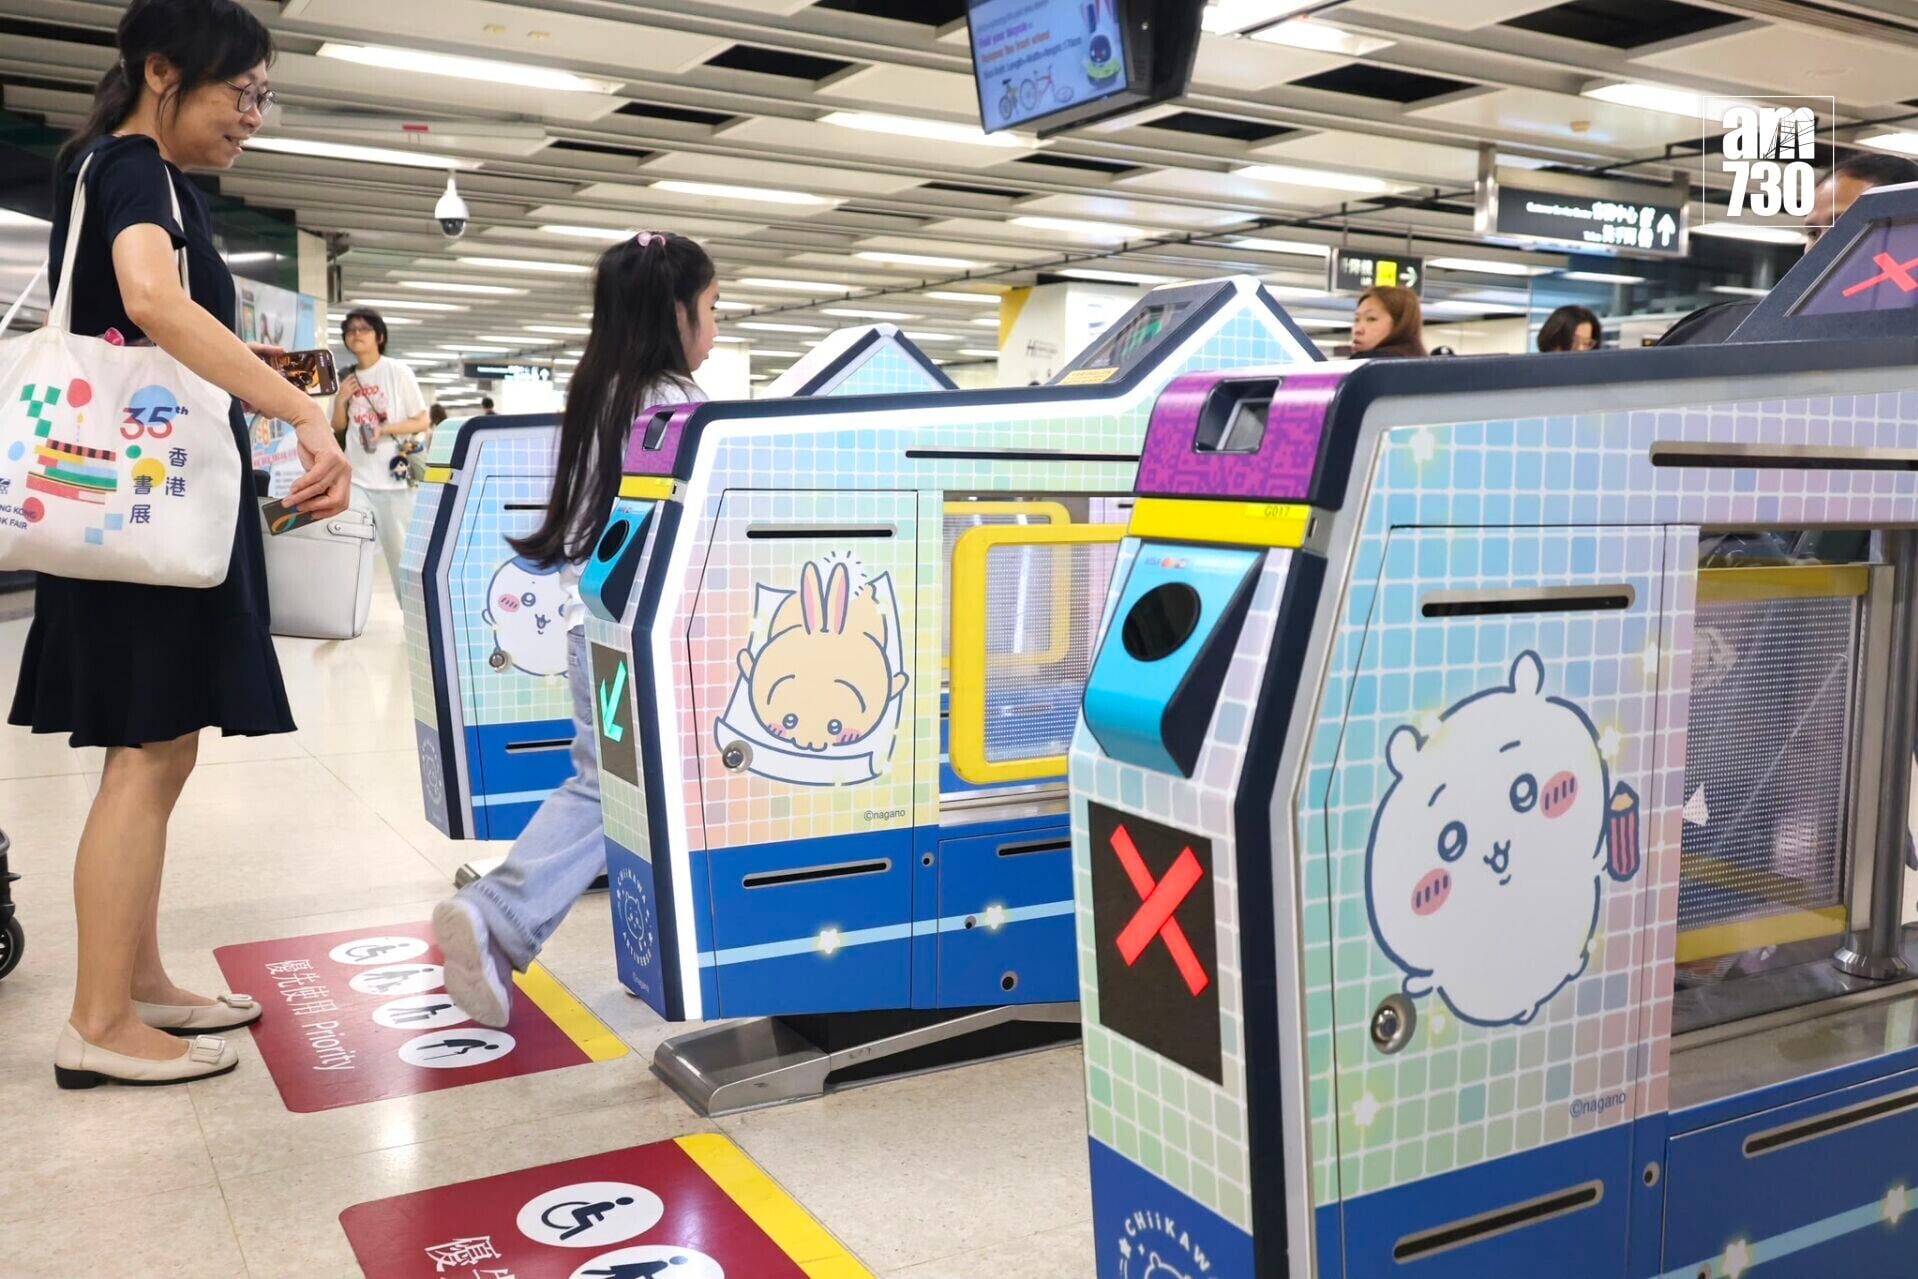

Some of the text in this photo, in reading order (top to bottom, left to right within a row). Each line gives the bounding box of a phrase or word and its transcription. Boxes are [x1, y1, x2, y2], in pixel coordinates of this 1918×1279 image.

[165, 447, 188, 497] 香港
[129, 475, 153, 524] 書展
[264, 959, 357, 1070] 優先使用 Priority
